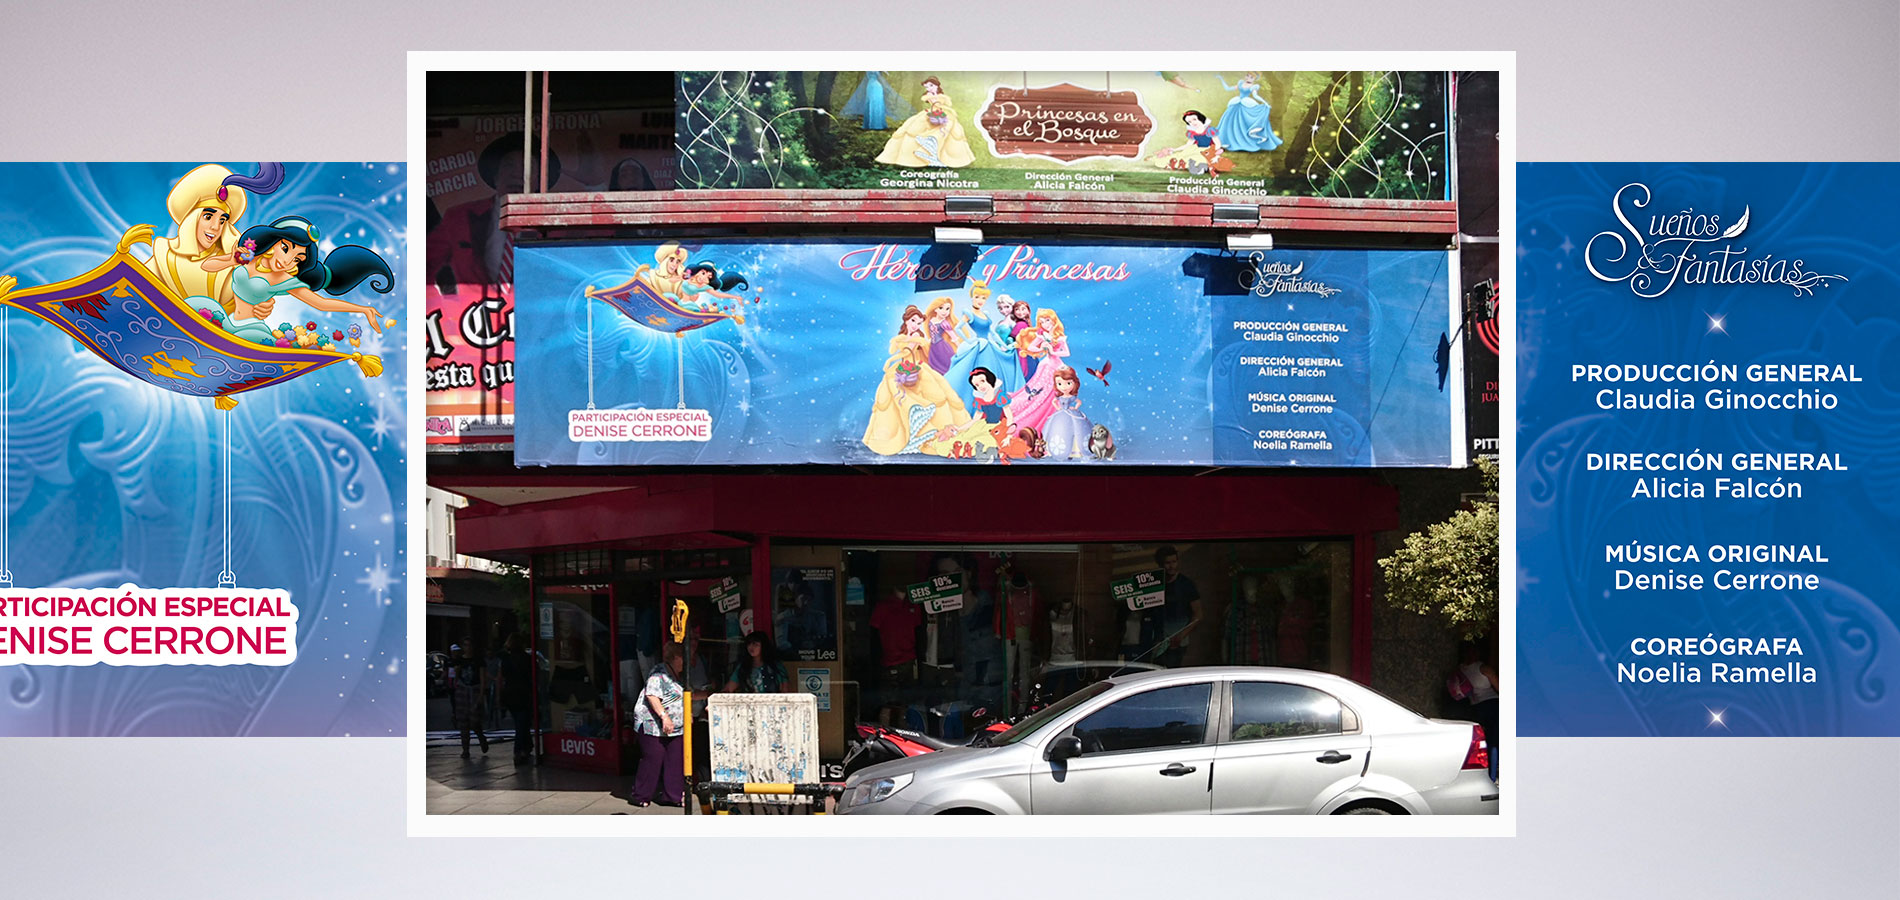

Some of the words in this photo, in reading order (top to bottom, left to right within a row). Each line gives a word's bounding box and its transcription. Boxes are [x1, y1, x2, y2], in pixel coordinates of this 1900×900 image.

[995, 101, 1109, 125] Princesas
[1113, 111, 1138, 123] en
[1013, 119, 1035, 137] el
[1033, 119, 1121, 146] Bosque
[900, 168, 959, 179] Coreografía
[1025, 172, 1072, 181] Dirección
[1074, 173, 1114, 182] General
[880, 178, 934, 189] Georgina
[936, 179, 979, 188] Nicotra
[1033, 180, 1066, 190] Alicia
[1068, 182, 1106, 191] Falcón
[1169, 176, 1224, 186] Producción
[1226, 178, 1265, 187] General
[1166, 184, 1210, 194] Claudia
[1211, 185, 1268, 196] Ginocchio
[977, 243, 1132, 283] Princesas
[1233, 320, 1300, 331] PRODUCCIÓN
[1302, 322, 1349, 332] GENERAL
[1243, 331, 1284, 342] Claudia
[1286, 332, 1340, 343] Ginocchio
[1240, 355, 1295, 366] DIRECCIÓN
[1297, 357, 1344, 367] GENERAL
[1258, 367, 1288, 377] Alicia
[1291, 367, 1326, 377] Falcón
[1572, 359, 1737, 383] PRODUCCIÓN
[1746, 364, 1863, 382] GENERAL
[1248, 391, 1287, 402] MÚSICA
[1288, 393, 1337, 403] ORIGINAL
[1596, 388, 1695, 410] Claudia
[1704, 388, 1838, 410] Ginocchio
[1252, 403, 1288, 413] Denise
[1290, 403, 1333, 414] Cerrone
[572, 410, 654, 422] PARTICIPACIÓN
[656, 412, 709, 422] ESPECIAL
[573, 424, 628, 438] DENISE
[631, 424, 708, 438] CERRONE
[1258, 428, 1327, 439] COREÓGRAFA
[1253, 440, 1288, 450] Noelia
[1290, 440, 1333, 450] Ramella
[1587, 448, 1723, 471] DIRECCIÓN
[1731, 453, 1848, 471] GENERAL
[1631, 476, 1705, 499] Alicia
[1715, 476, 1802, 499] Falcón
[1605, 540, 1700, 563] MÚSICA
[1708, 544, 1829, 563] ORIGINAL
[1615, 568, 1704, 590] Denise
[1713, 569, 1820, 590] Cerrone
[910, 586, 931, 599] SEIS
[1113, 583, 1134, 595] SEIS
[164, 596, 291, 617] ESPECIAL
[103, 625, 287, 655] CERRONE
[1630, 632, 1804, 656] COREÓGRAFA
[817, 649, 836, 660] Lee
[1617, 661, 1701, 683] Noelia
[1711, 661, 1817, 683] Ramella
